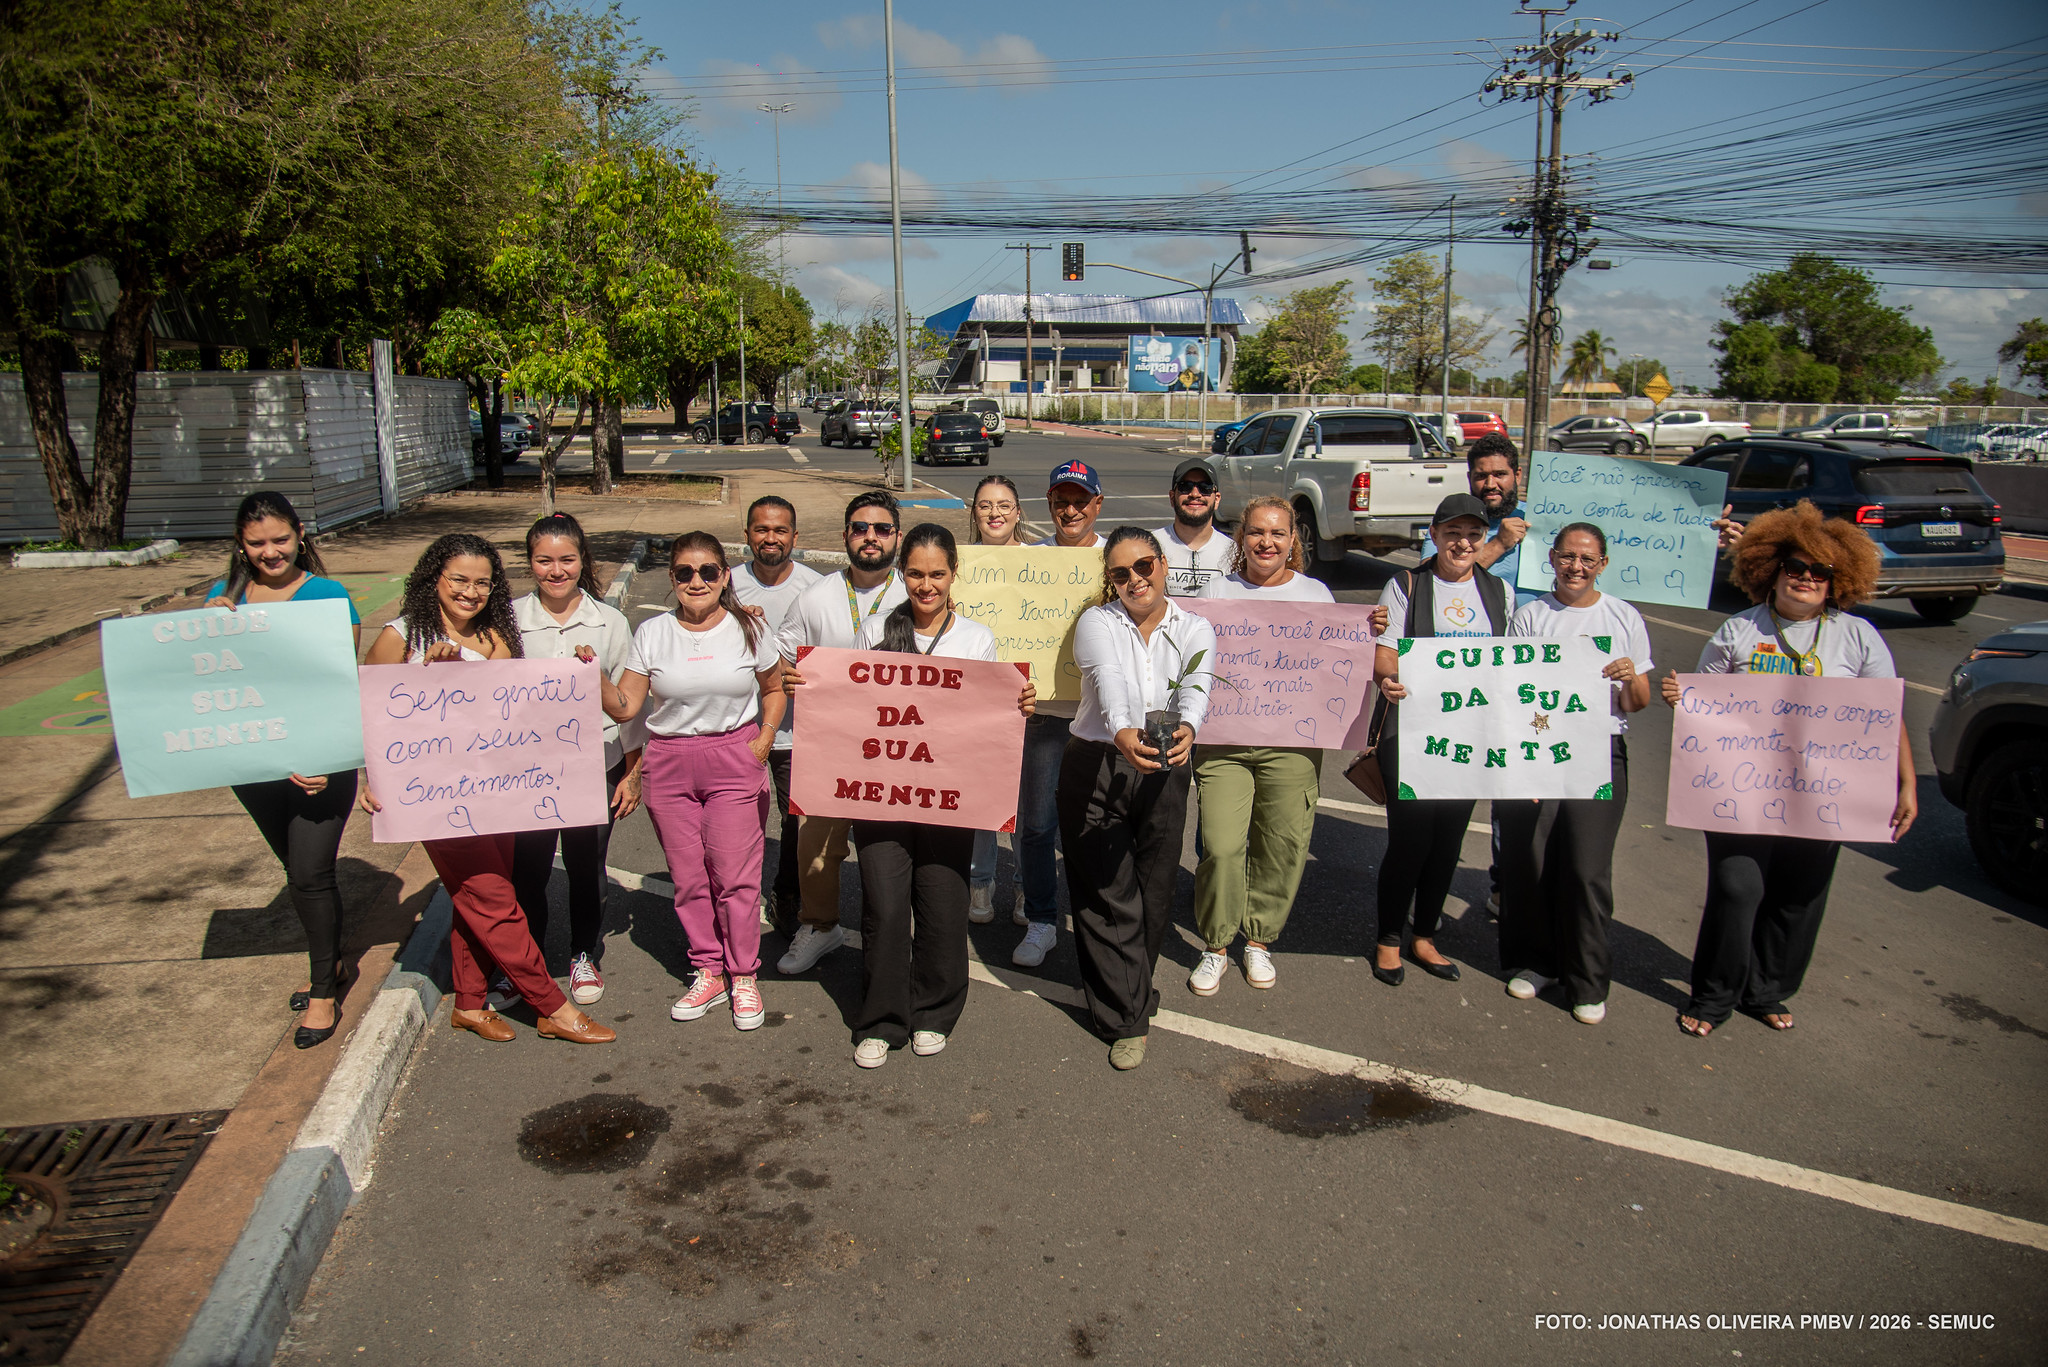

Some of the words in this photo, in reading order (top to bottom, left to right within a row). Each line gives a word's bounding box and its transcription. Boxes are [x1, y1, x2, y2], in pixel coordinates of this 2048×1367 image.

[1149, 363, 1178, 375] para
[1057, 472, 1087, 481] RORAIMA
[1536, 456, 1586, 484] Você
[1591, 466, 1624, 486] não
[1630, 474, 1708, 496] precisa
[1533, 496, 1573, 515] dar
[1643, 502, 1666, 523] de
[1017, 563, 1059, 585] dia
[1067, 565, 1093, 585] de
[1175, 571, 1212, 585] VANS
[152, 610, 271, 643] CUIDE
[955, 601, 1003, 628] vez
[1213, 618, 1260, 637] ando
[1268, 620, 1314, 640] você
[1318, 623, 1373, 643] cuida
[191, 649, 244, 676] DA
[1272, 650, 1324, 670] tudo
[1435, 644, 1561, 669] CUIDE
[848, 661, 964, 690] CUIDE
[1262, 675, 1313, 693] mais
[191, 686, 265, 715] SUA
[386, 682, 476, 721] Seja
[492, 674, 587, 721] gentil
[1440, 687, 1489, 713] DA
[1517, 683, 1588, 713] SUA
[876, 704, 925, 727] DA
[163, 717, 288, 754] MENTE
[466, 728, 542, 752] seus
[1680, 735, 1708, 753] a
[1716, 728, 1792, 753] mente
[1796, 740, 1890, 768] precisa
[862, 738, 934, 763] SUA
[1424, 735, 1572, 768] MENTE
[1691, 764, 1725, 789] de
[834, 778, 961, 811] MENTE
